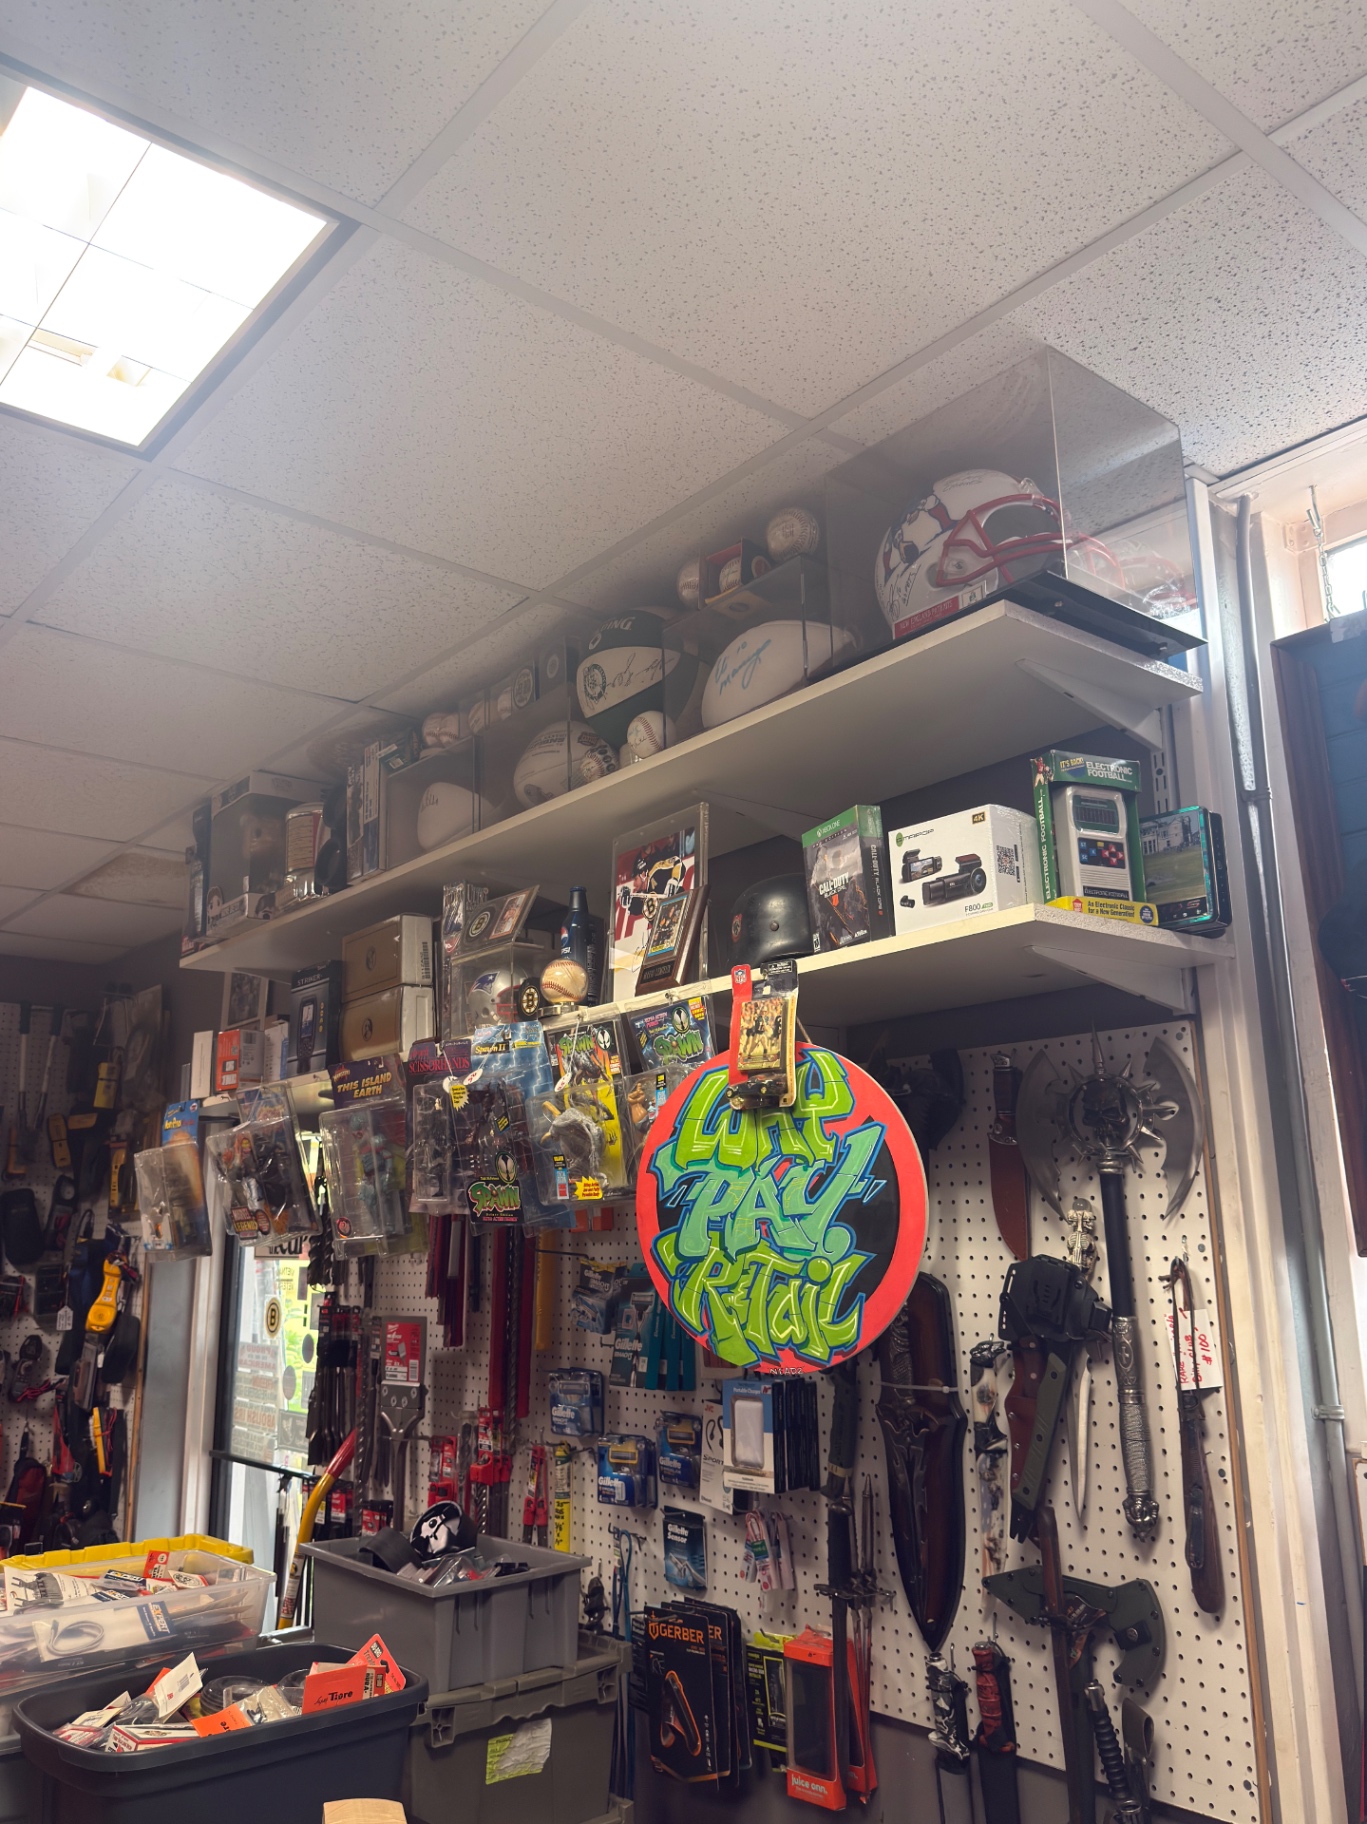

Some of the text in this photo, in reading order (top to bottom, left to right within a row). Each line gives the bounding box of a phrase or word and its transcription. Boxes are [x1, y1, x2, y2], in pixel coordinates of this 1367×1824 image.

[1086, 761, 1133, 776] ELECTRONIC
[1087, 769, 1126, 782] FOOTBALL
[973, 813, 985, 822] 4K
[1038, 797, 1051, 900] ELECTRONIC FOOTBALL
[819, 879, 831, 895] CALL
[833, 871, 850, 888] DUTY
[1096, 901, 1118, 909] Electronic
[1120, 903, 1135, 911] Classic
[409, 1057, 471, 1073] SCISSORHANDS
[337, 1072, 392, 1093] THIS ISLAND
[353, 1085, 382, 1099] EARTH
[468, 1181, 521, 1217] SPAWN
[615, 1338, 643, 1351] Gillette
[552, 1406, 575, 1419] Gillette
[660, 1456, 682, 1469] Gillette
[667, 1523, 689, 1536] Gillette
[667, 1531, 687, 1543] Sensor
[659, 1623, 704, 1645] GERBER
